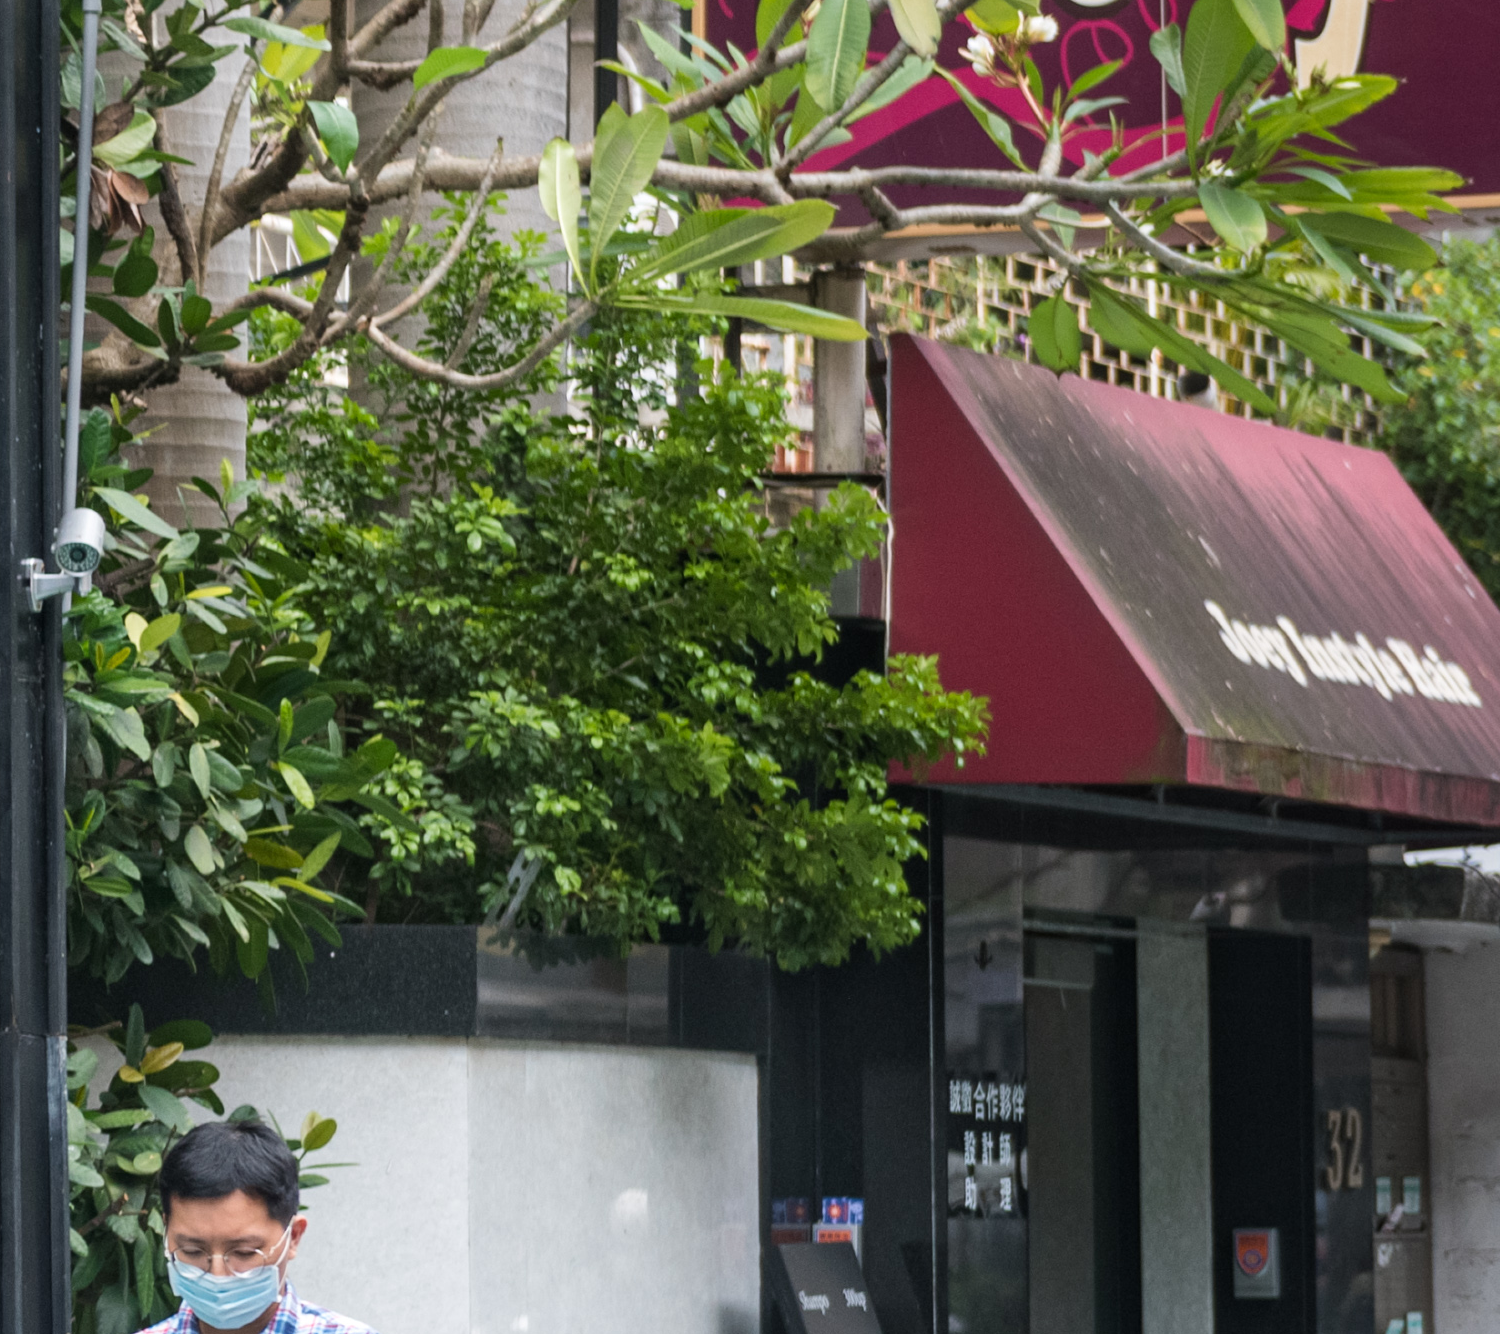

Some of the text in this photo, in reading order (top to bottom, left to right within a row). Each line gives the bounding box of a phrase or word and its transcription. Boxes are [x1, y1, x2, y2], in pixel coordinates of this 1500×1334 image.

[1204, 599, 1308, 688] Joey
[1385, 637, 1482, 708] Hair
[963, 1130, 1012, 1167] 設計師
[1327, 1107, 1363, 1191] 32
